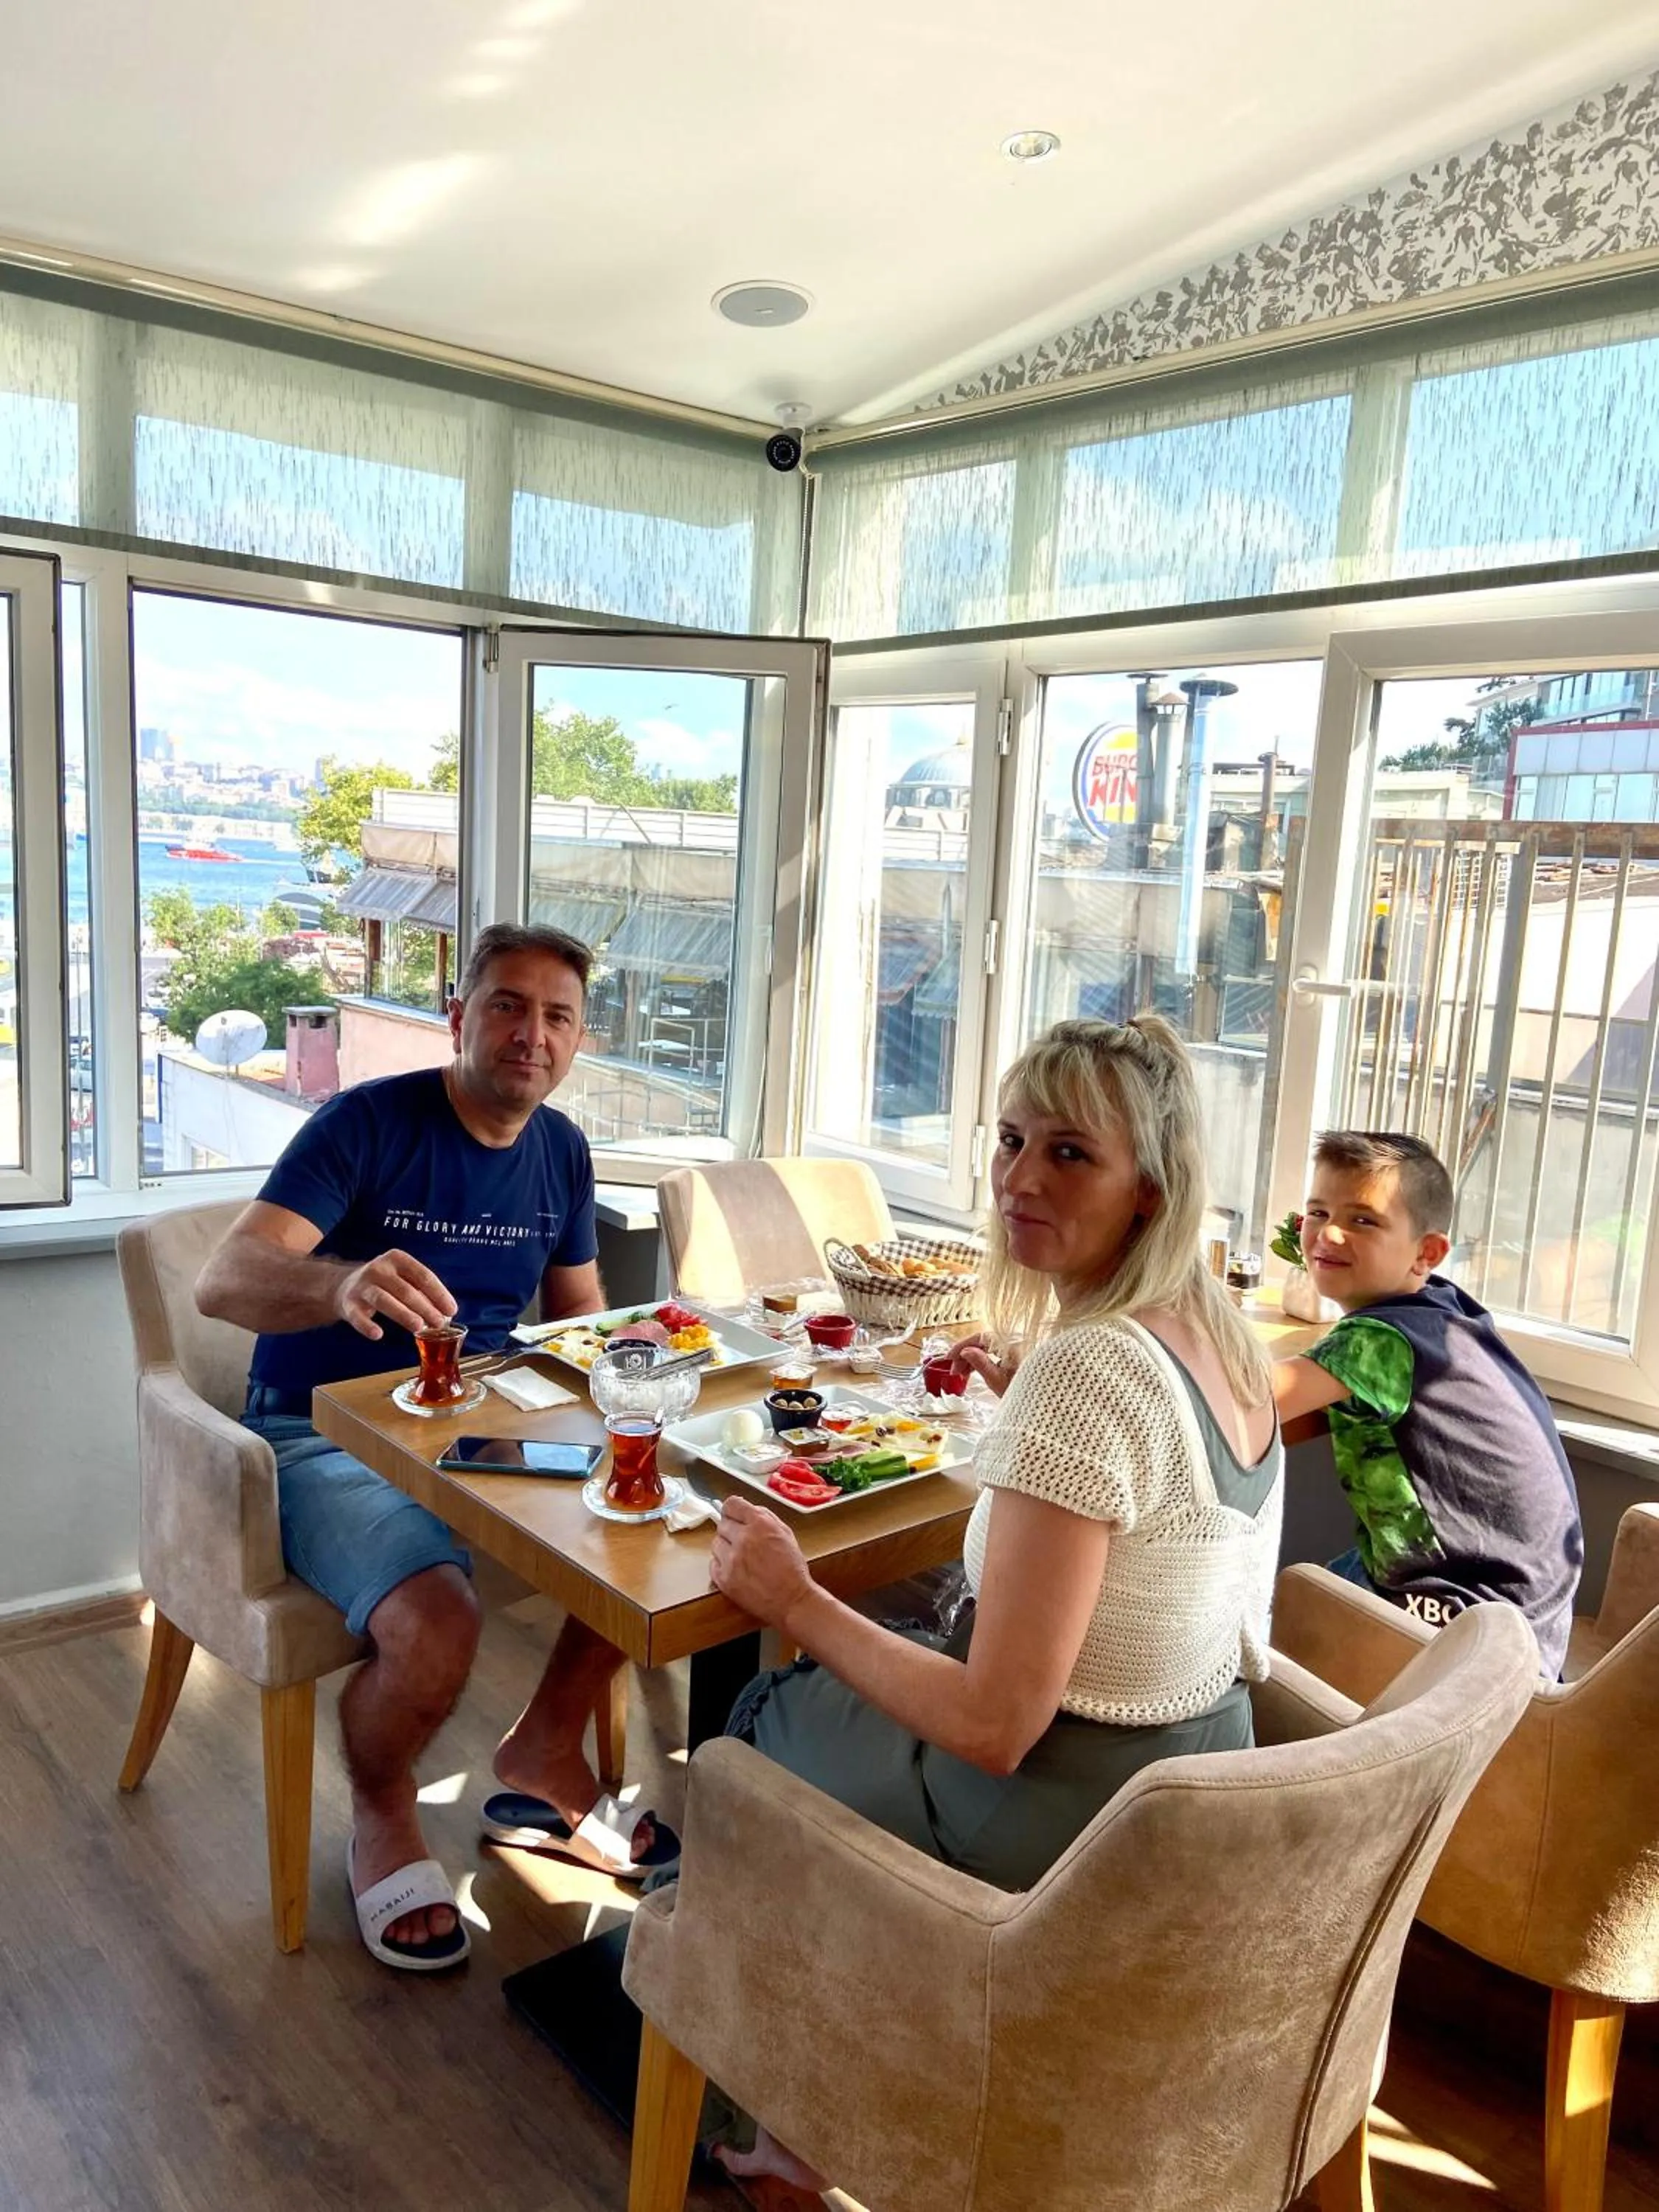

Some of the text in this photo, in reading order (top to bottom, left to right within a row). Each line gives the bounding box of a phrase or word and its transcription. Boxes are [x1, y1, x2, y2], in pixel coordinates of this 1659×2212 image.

[1091, 754, 1137, 776] BURG
[1088, 777, 1138, 807] KIN
[384, 1216, 409, 1229] FOR
[417, 1220, 456, 1234] GLORY
[461, 1224, 481, 1234] AND
[486, 1225, 530, 1238] VICTORY
